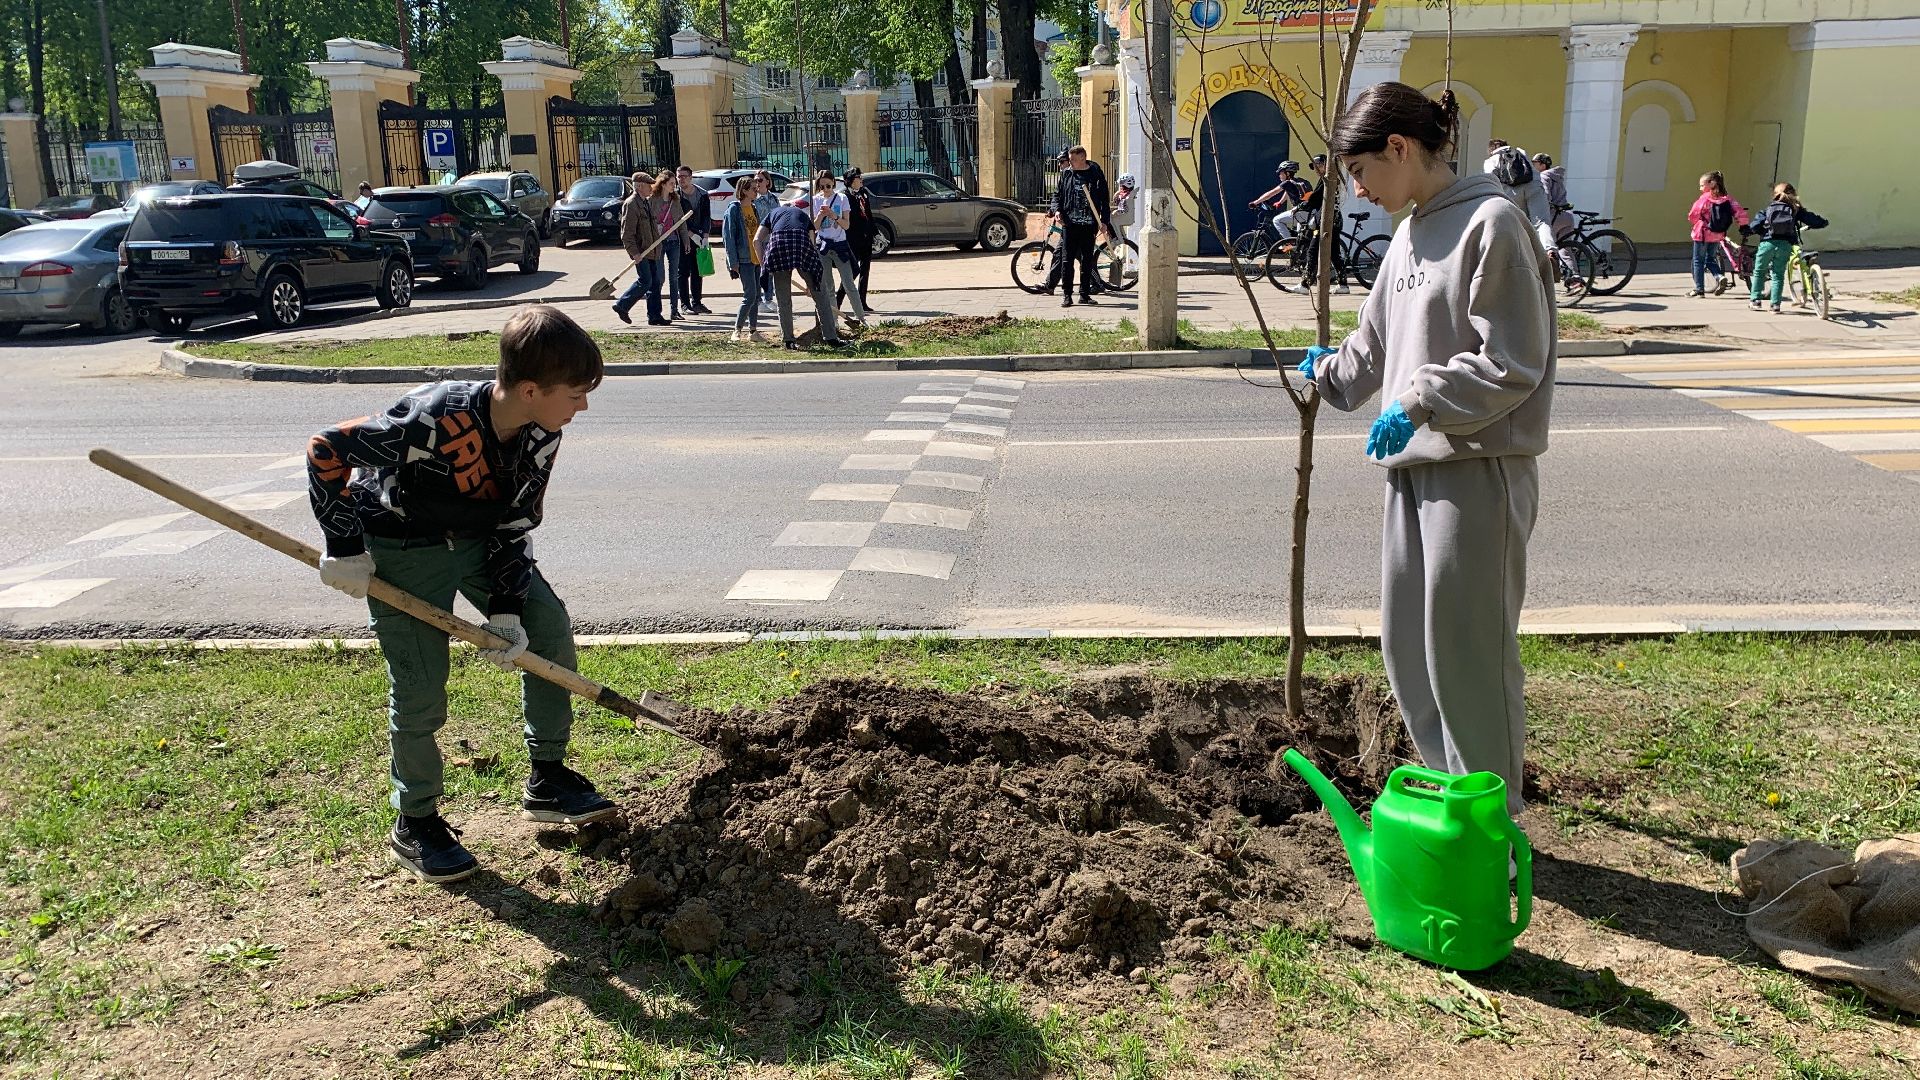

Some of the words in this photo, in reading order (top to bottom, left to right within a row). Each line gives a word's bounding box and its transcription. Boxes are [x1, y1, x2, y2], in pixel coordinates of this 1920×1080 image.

[1178, 64, 1314, 122] ПРОДУКТЫ
[432, 132, 448, 153] P
[1420, 914, 1462, 955] 12
